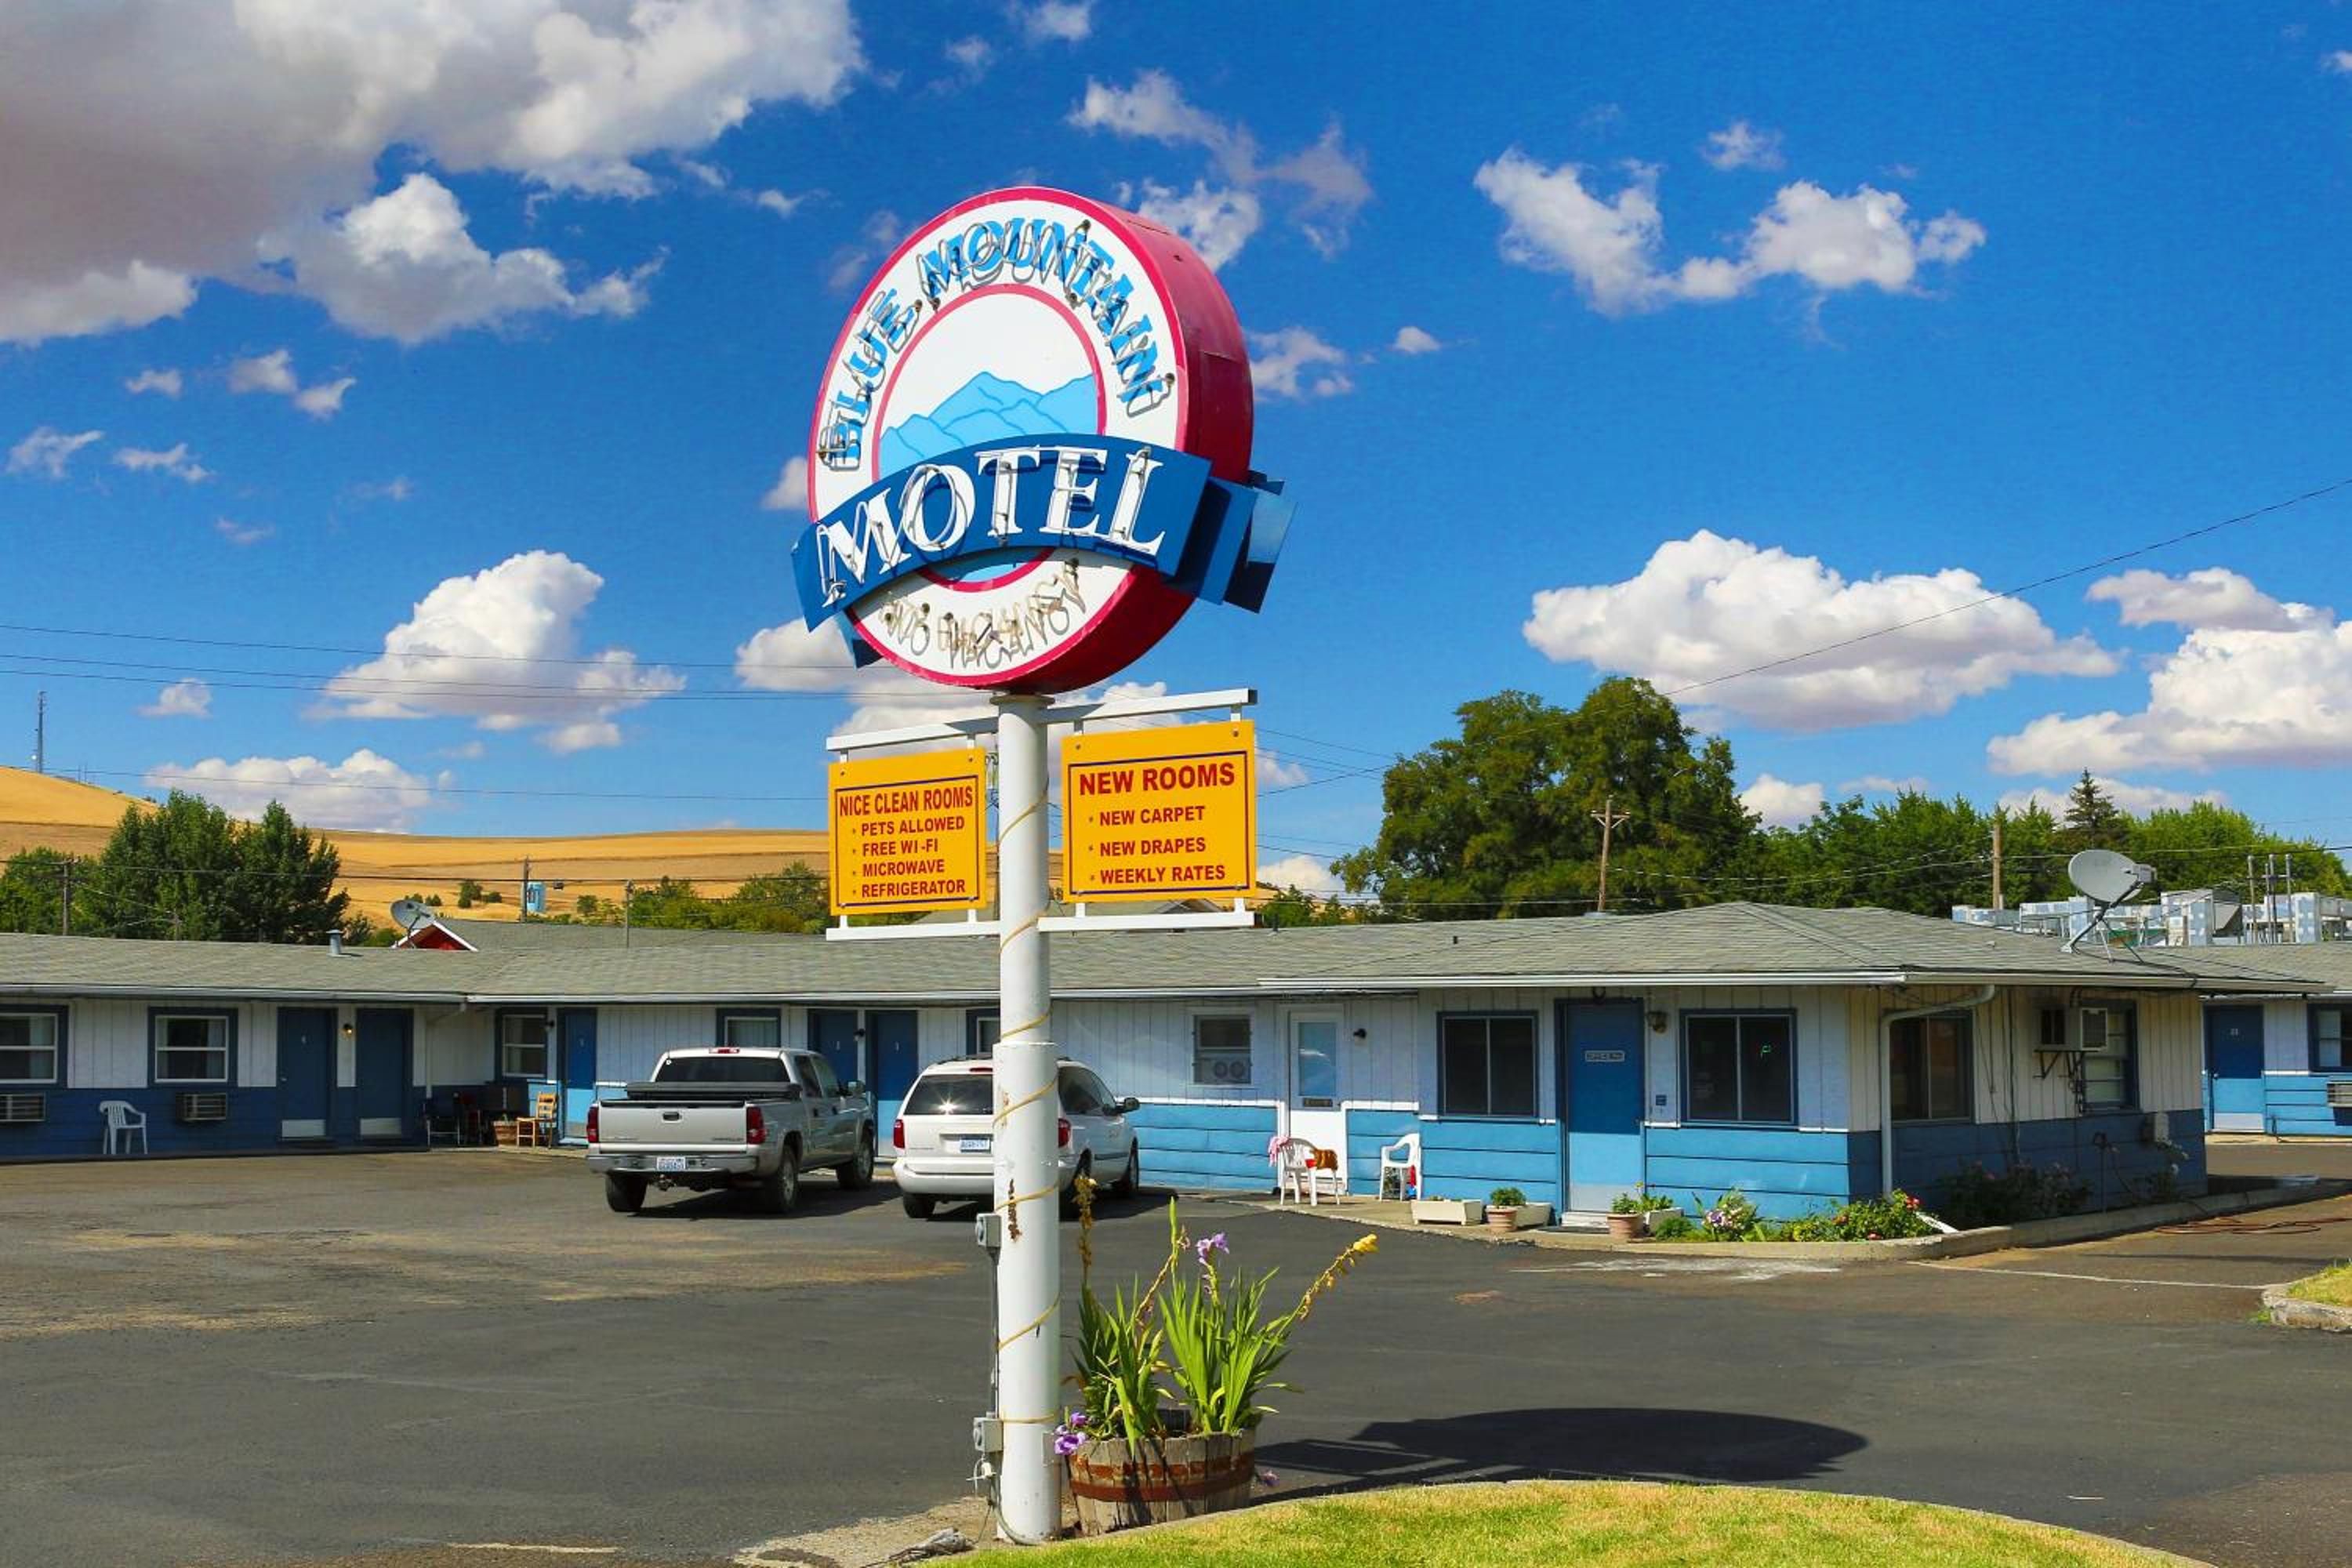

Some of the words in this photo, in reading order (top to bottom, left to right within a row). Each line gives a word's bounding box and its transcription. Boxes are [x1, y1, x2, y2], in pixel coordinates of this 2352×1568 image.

[822, 288, 917, 469] BLUE
[918, 217, 1168, 409] MOUNTAIN
[817, 445, 1166, 608] MOTEL
[1080, 769, 1134, 796] NEW
[1142, 762, 1235, 791] ROOMS
[839, 794, 871, 817] NICE
[874, 790, 919, 815] CLEAN
[923, 786, 973, 811] ROOMS
[861, 821, 895, 837] PETS
[898, 815, 965, 834] ALLOWED
[1099, 810, 1135, 826] NEW
[1140, 805, 1205, 824] CARPET
[862, 841, 896, 857] FREE
[1100, 841, 1136, 857] NEW
[1141, 837, 1207, 855] DRAPES
[862, 858, 945, 877] MICROWAVE
[1100, 867, 1166, 884] WEEKLY
[1172, 864, 1225, 882] RATES
[862, 879, 966, 898] REFRIGERATOR
